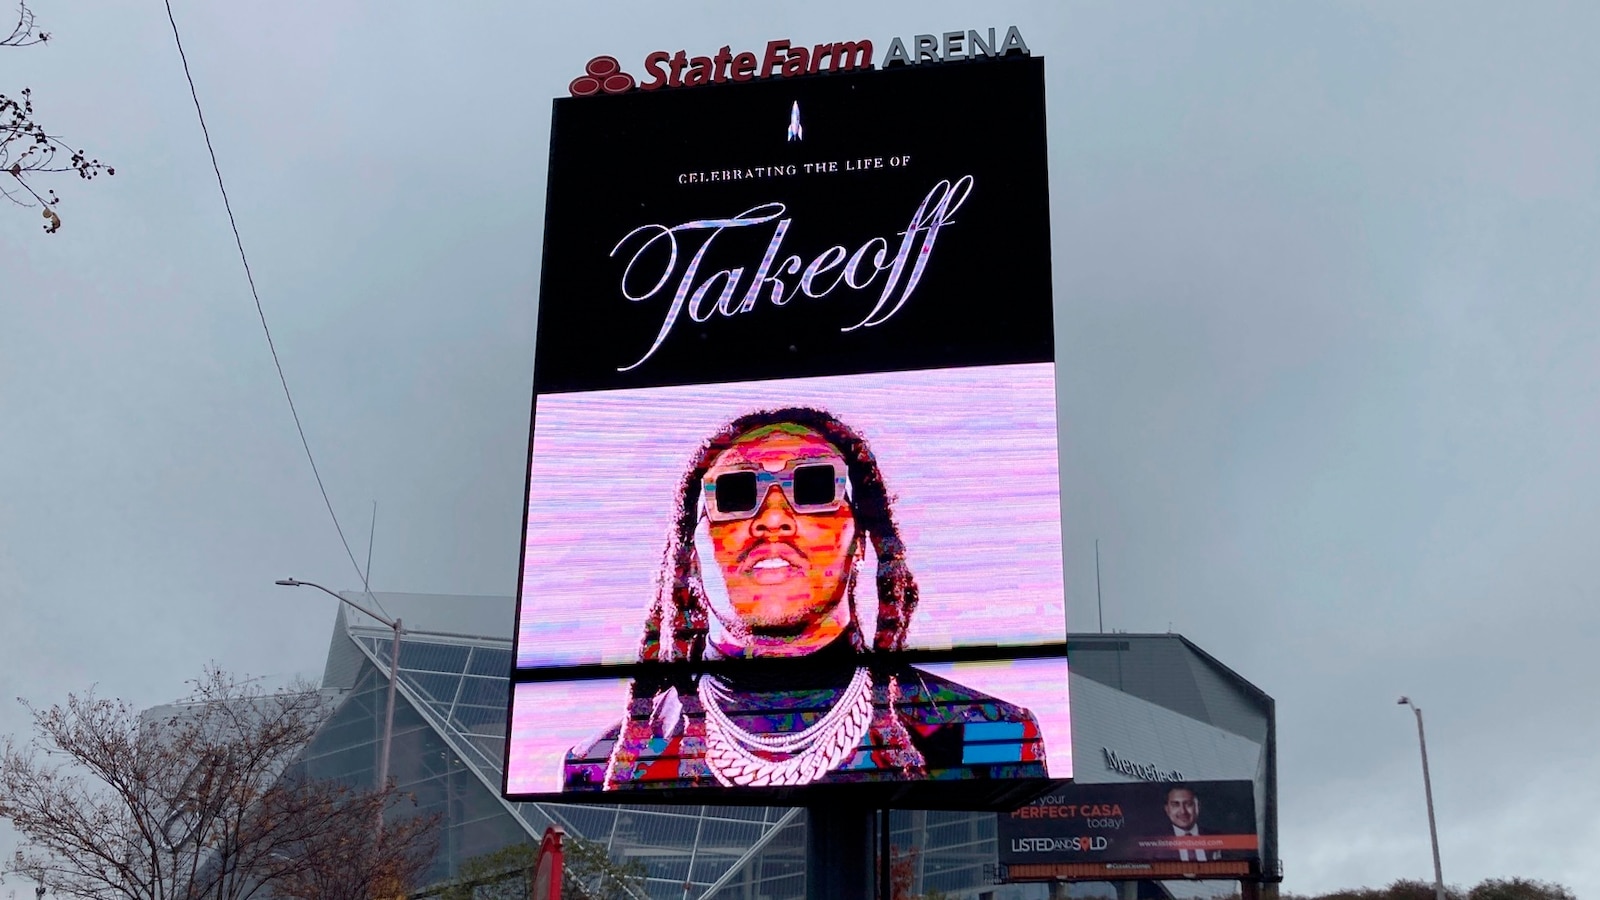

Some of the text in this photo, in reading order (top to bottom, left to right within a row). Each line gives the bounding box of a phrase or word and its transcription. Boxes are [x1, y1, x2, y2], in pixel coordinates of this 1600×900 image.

[882, 25, 1029, 67] ARENA
[678, 155, 912, 184] CELEBRATING THE LIFE OF
[610, 175, 974, 371] Takeoff
[1040, 795, 1066, 807] your
[1080, 804, 1123, 817] CASA
[1087, 816, 1125, 830] today!
